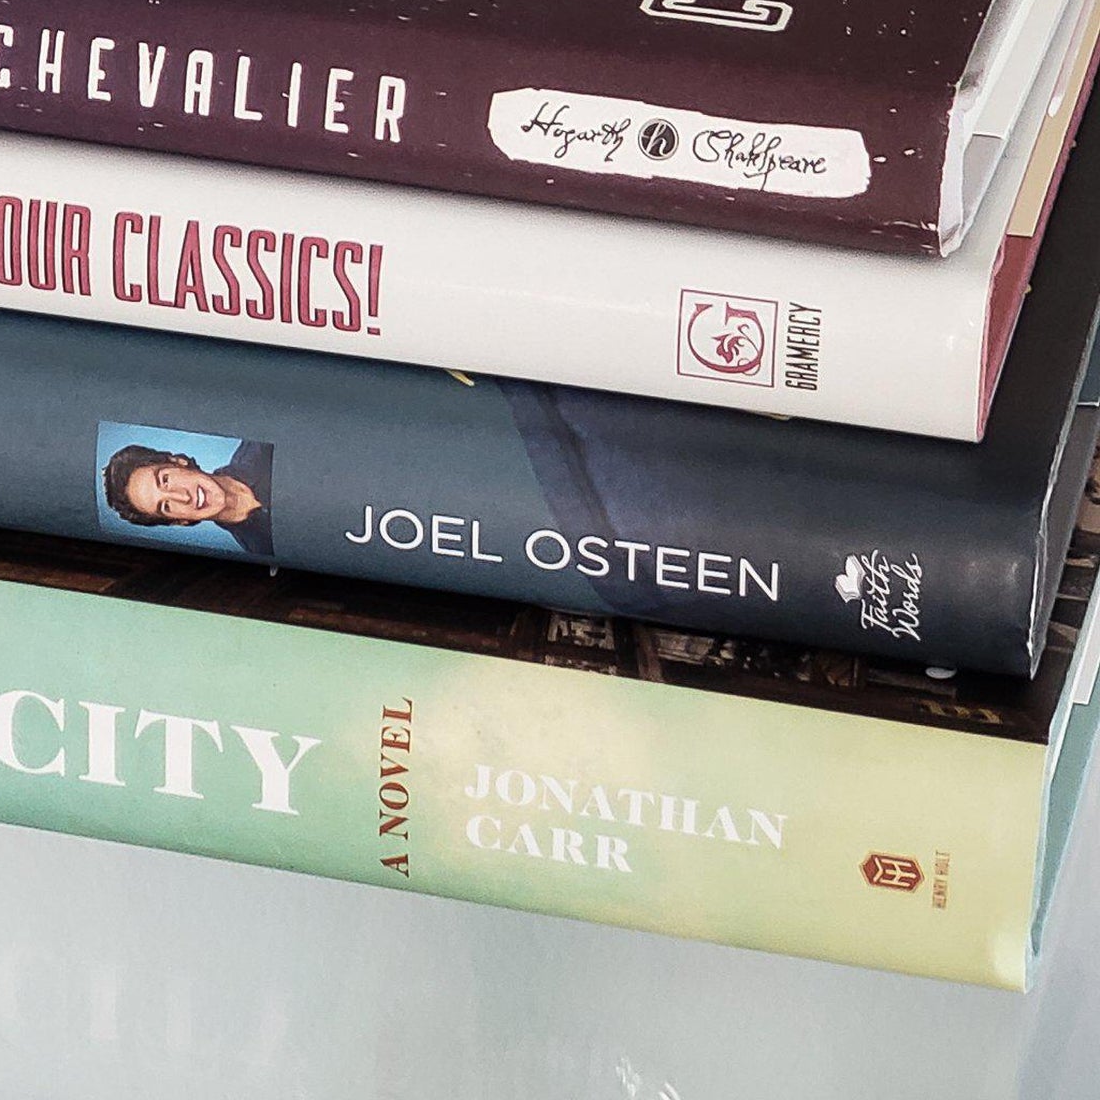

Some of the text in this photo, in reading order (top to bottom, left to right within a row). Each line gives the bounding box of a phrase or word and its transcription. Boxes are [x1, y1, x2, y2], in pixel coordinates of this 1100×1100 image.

[521, 102, 631, 162] Hogarth
[113, 212, 384, 336] CLASSICS!
[785, 302, 822, 390] GRAMERCY
[345, 505, 779, 602] JOEL OSTEEN
[860, 549, 893, 630] Faith
[890, 553, 923, 641] Words
[378, 696, 414, 878] A NOVEL
[464, 762, 789, 850] JONATHAN
[464, 815, 633, 874] CARR
